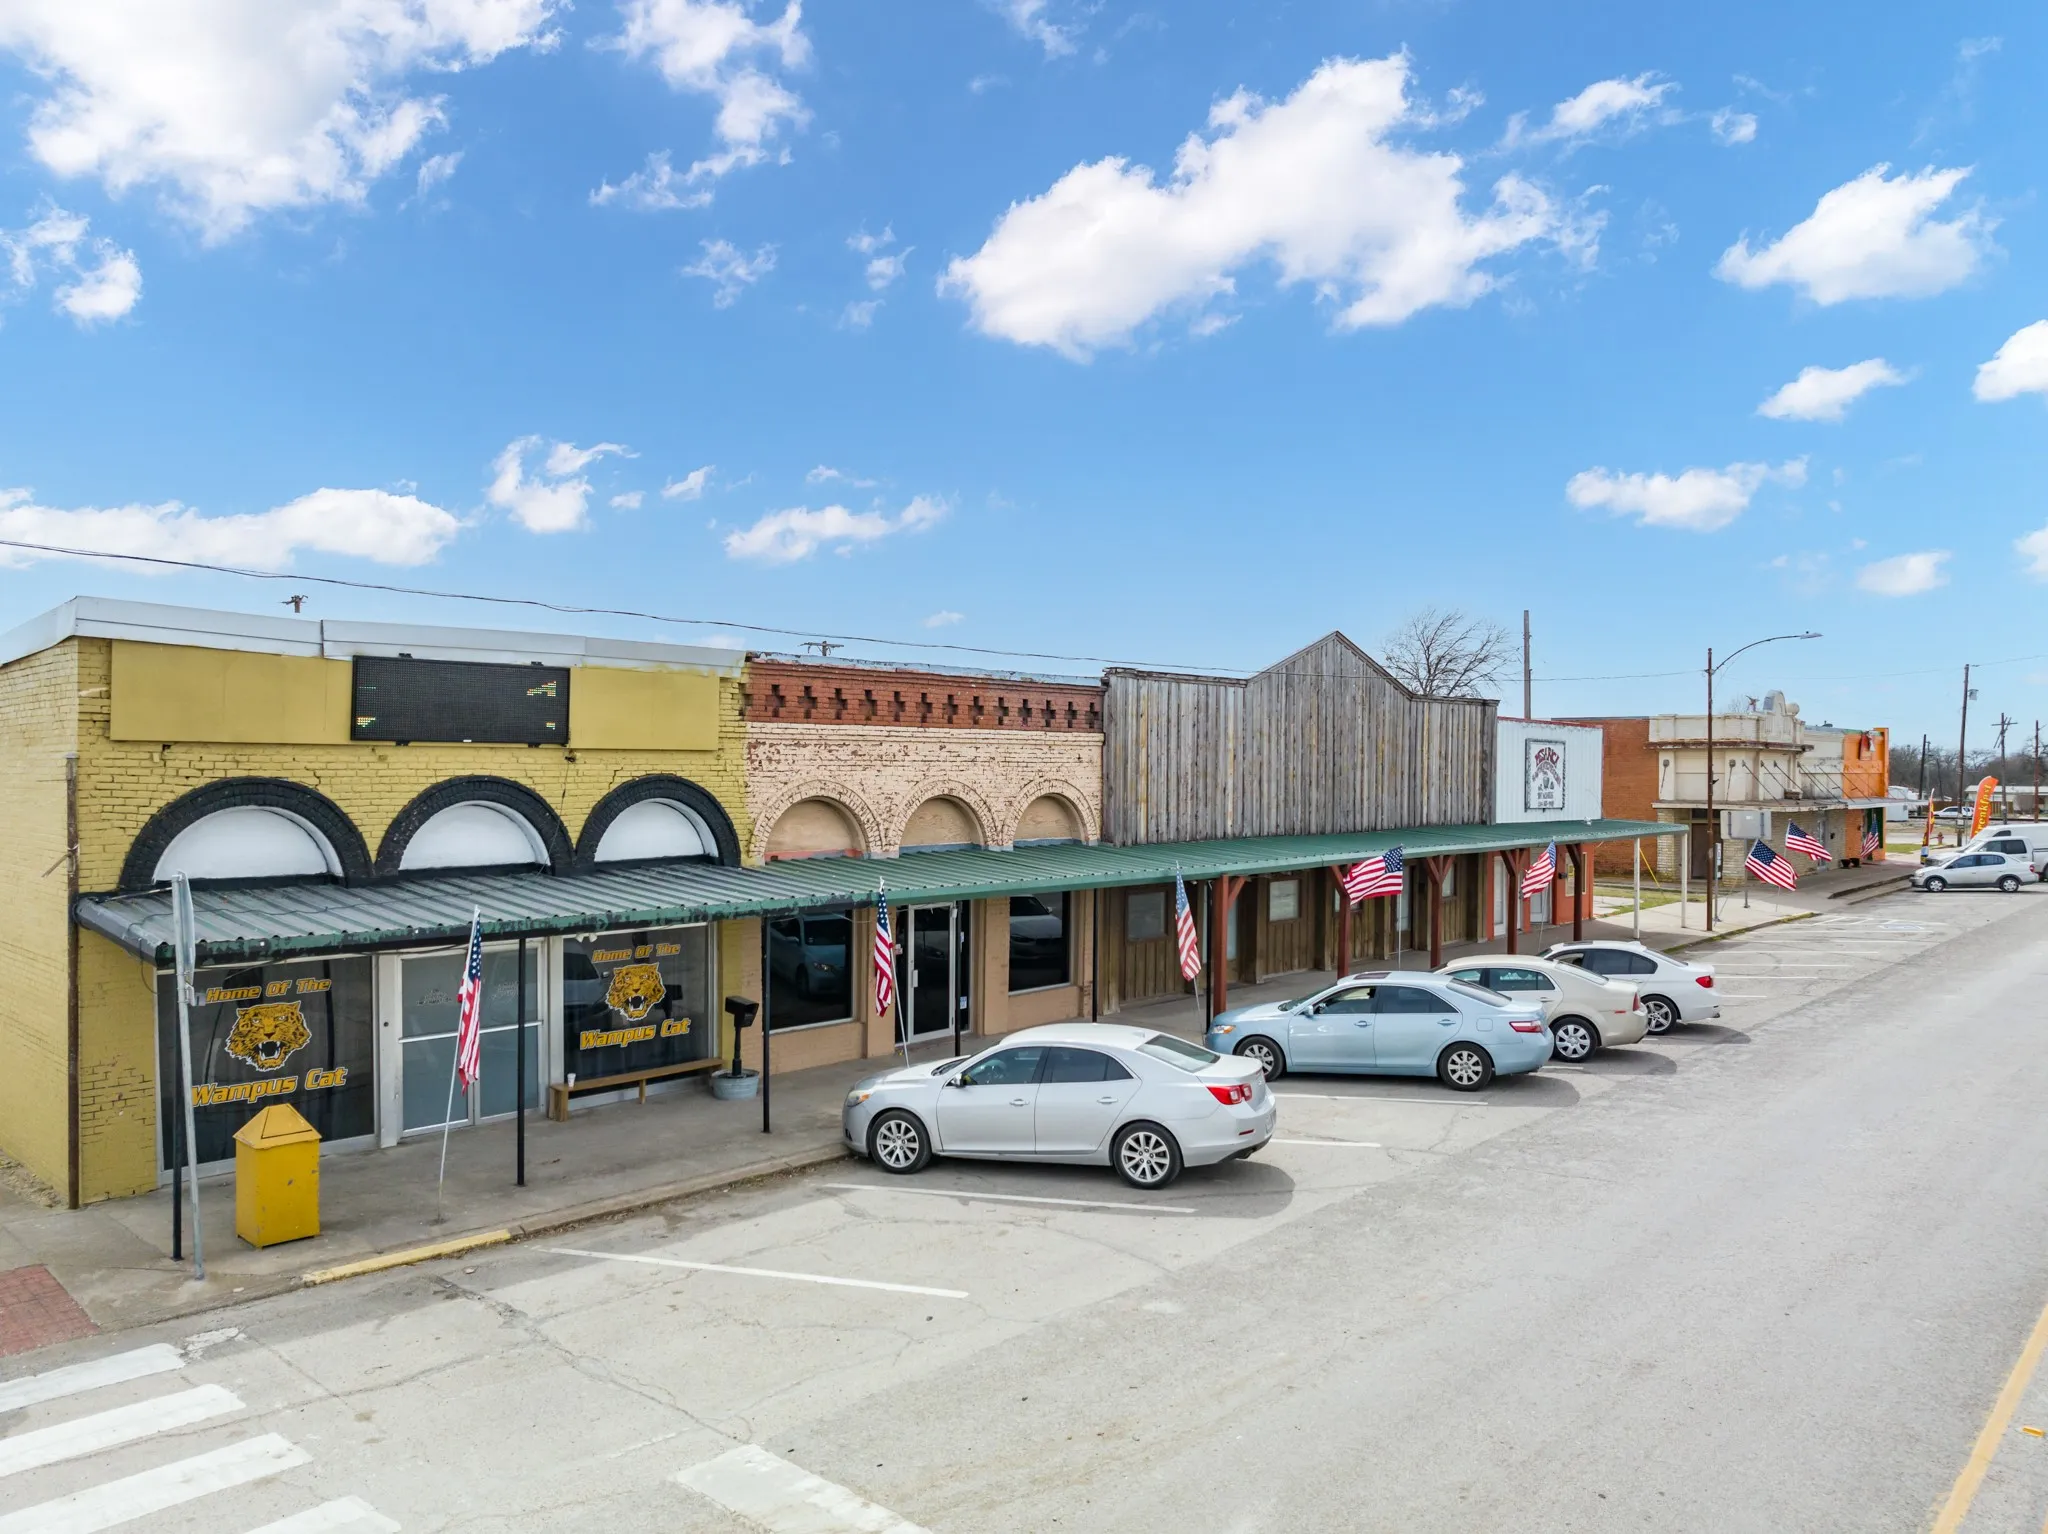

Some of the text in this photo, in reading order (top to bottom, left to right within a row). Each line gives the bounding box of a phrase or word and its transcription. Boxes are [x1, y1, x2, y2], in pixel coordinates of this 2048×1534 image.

[1974, 784, 1991, 834] reakfast
[592, 949, 632, 963] Home
[656, 943, 680, 956] The
[206, 978, 331, 1003] Home Of The
[580, 1018, 691, 1050] Wampus Cat
[192, 1067, 348, 1107] Wampus Cat
